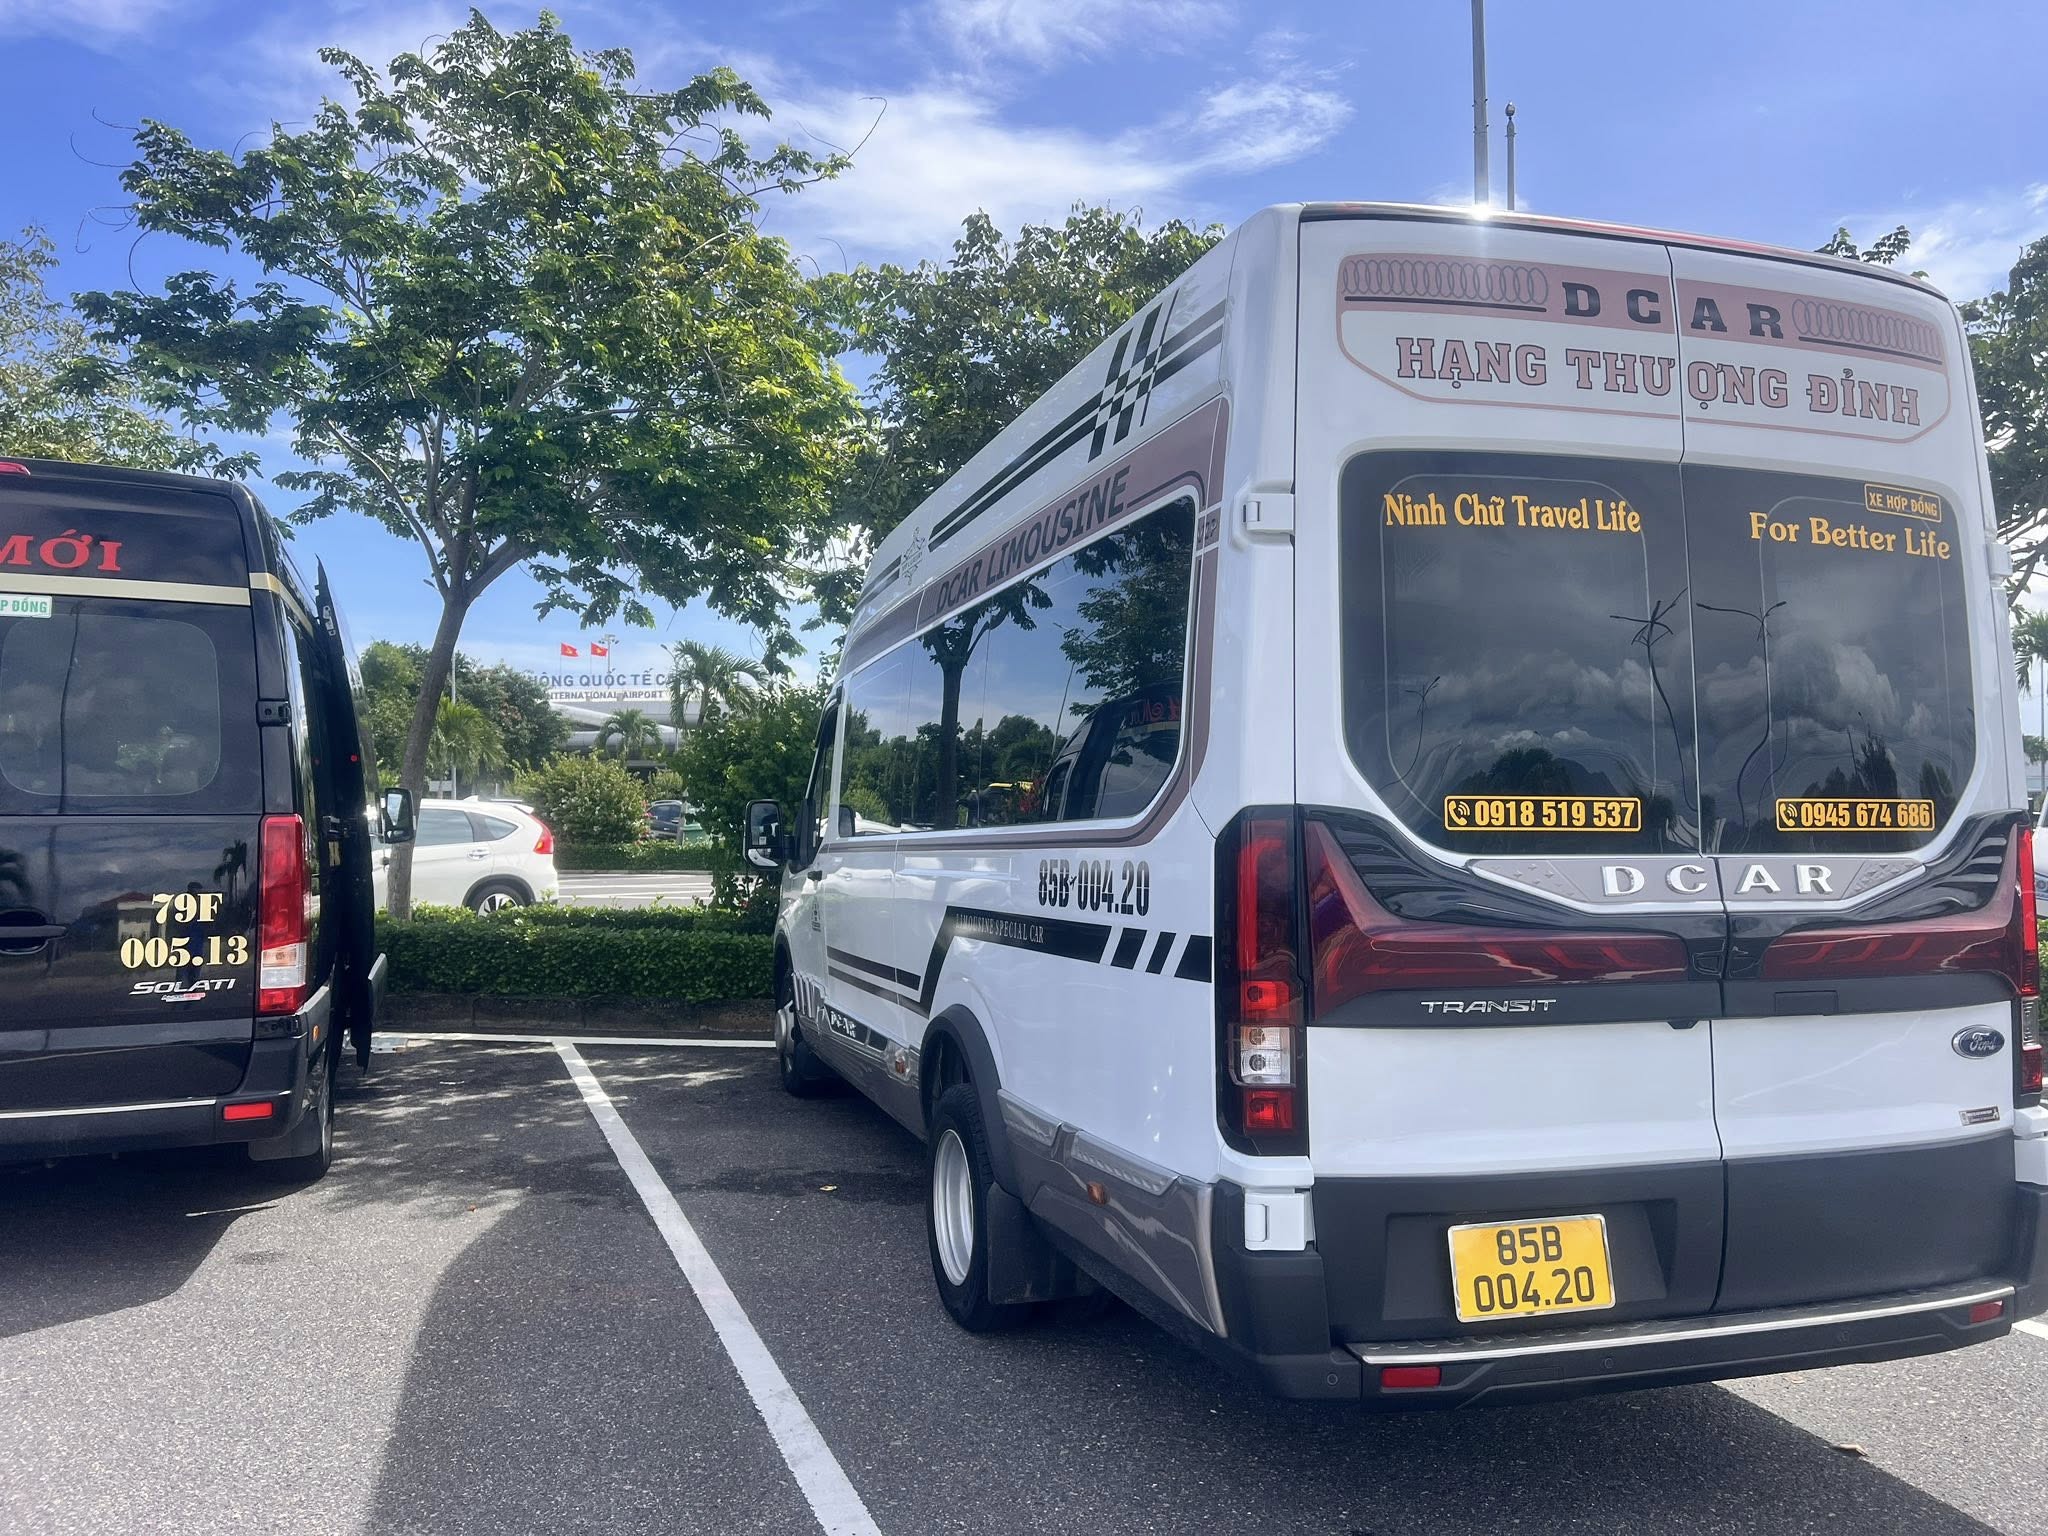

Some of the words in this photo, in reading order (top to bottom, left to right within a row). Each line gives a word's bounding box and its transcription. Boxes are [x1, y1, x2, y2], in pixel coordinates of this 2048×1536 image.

[1396, 336, 1546, 389] HẠNG
[1566, 348, 1789, 410] THƯỢNG
[1807, 367, 1921, 426] ĐỈNH
[1384, 493, 1446, 526] Ninh
[1454, 493, 1505, 526] Chữ
[1511, 495, 1590, 529] Travel
[1595, 499, 1641, 533] Life
[1869, 493, 1884, 507] XE
[1886, 495, 1908, 512] HỢP
[1911, 496, 1938, 517] ĐỒNG
[936, 566, 981, 612] DCAR
[985, 464, 1131, 585] LIMOUSINE
[1750, 511, 1799, 543] For
[1811, 518, 1897, 552] Better
[1904, 527, 1951, 560] Life
[579, 668, 627, 688] QUỐC
[630, 668, 653, 686] TẾ
[622, 690, 664, 699] AIRPORT
[1475, 801, 1538, 826] 0918
[1542, 801, 1589, 826] 519
[1593, 800, 1635, 827] 537
[1800, 803, 1852, 828] 0945
[1856, 803, 1893, 828] 674
[1897, 803, 1931, 828] 686
[152, 892, 223, 924] 79F
[955, 912, 994, 936] LIMOUSINE
[994, 920, 1028, 941] SPECIAL
[1029, 925, 1044, 944] CAR
[120, 935, 248, 968] 005.13
[129, 979, 236, 995] SOLATI
[1421, 999, 1557, 1014] TRANSIT
[1496, 1226, 1563, 1265] 85B
[1474, 1267, 1596, 1312] 004.20
